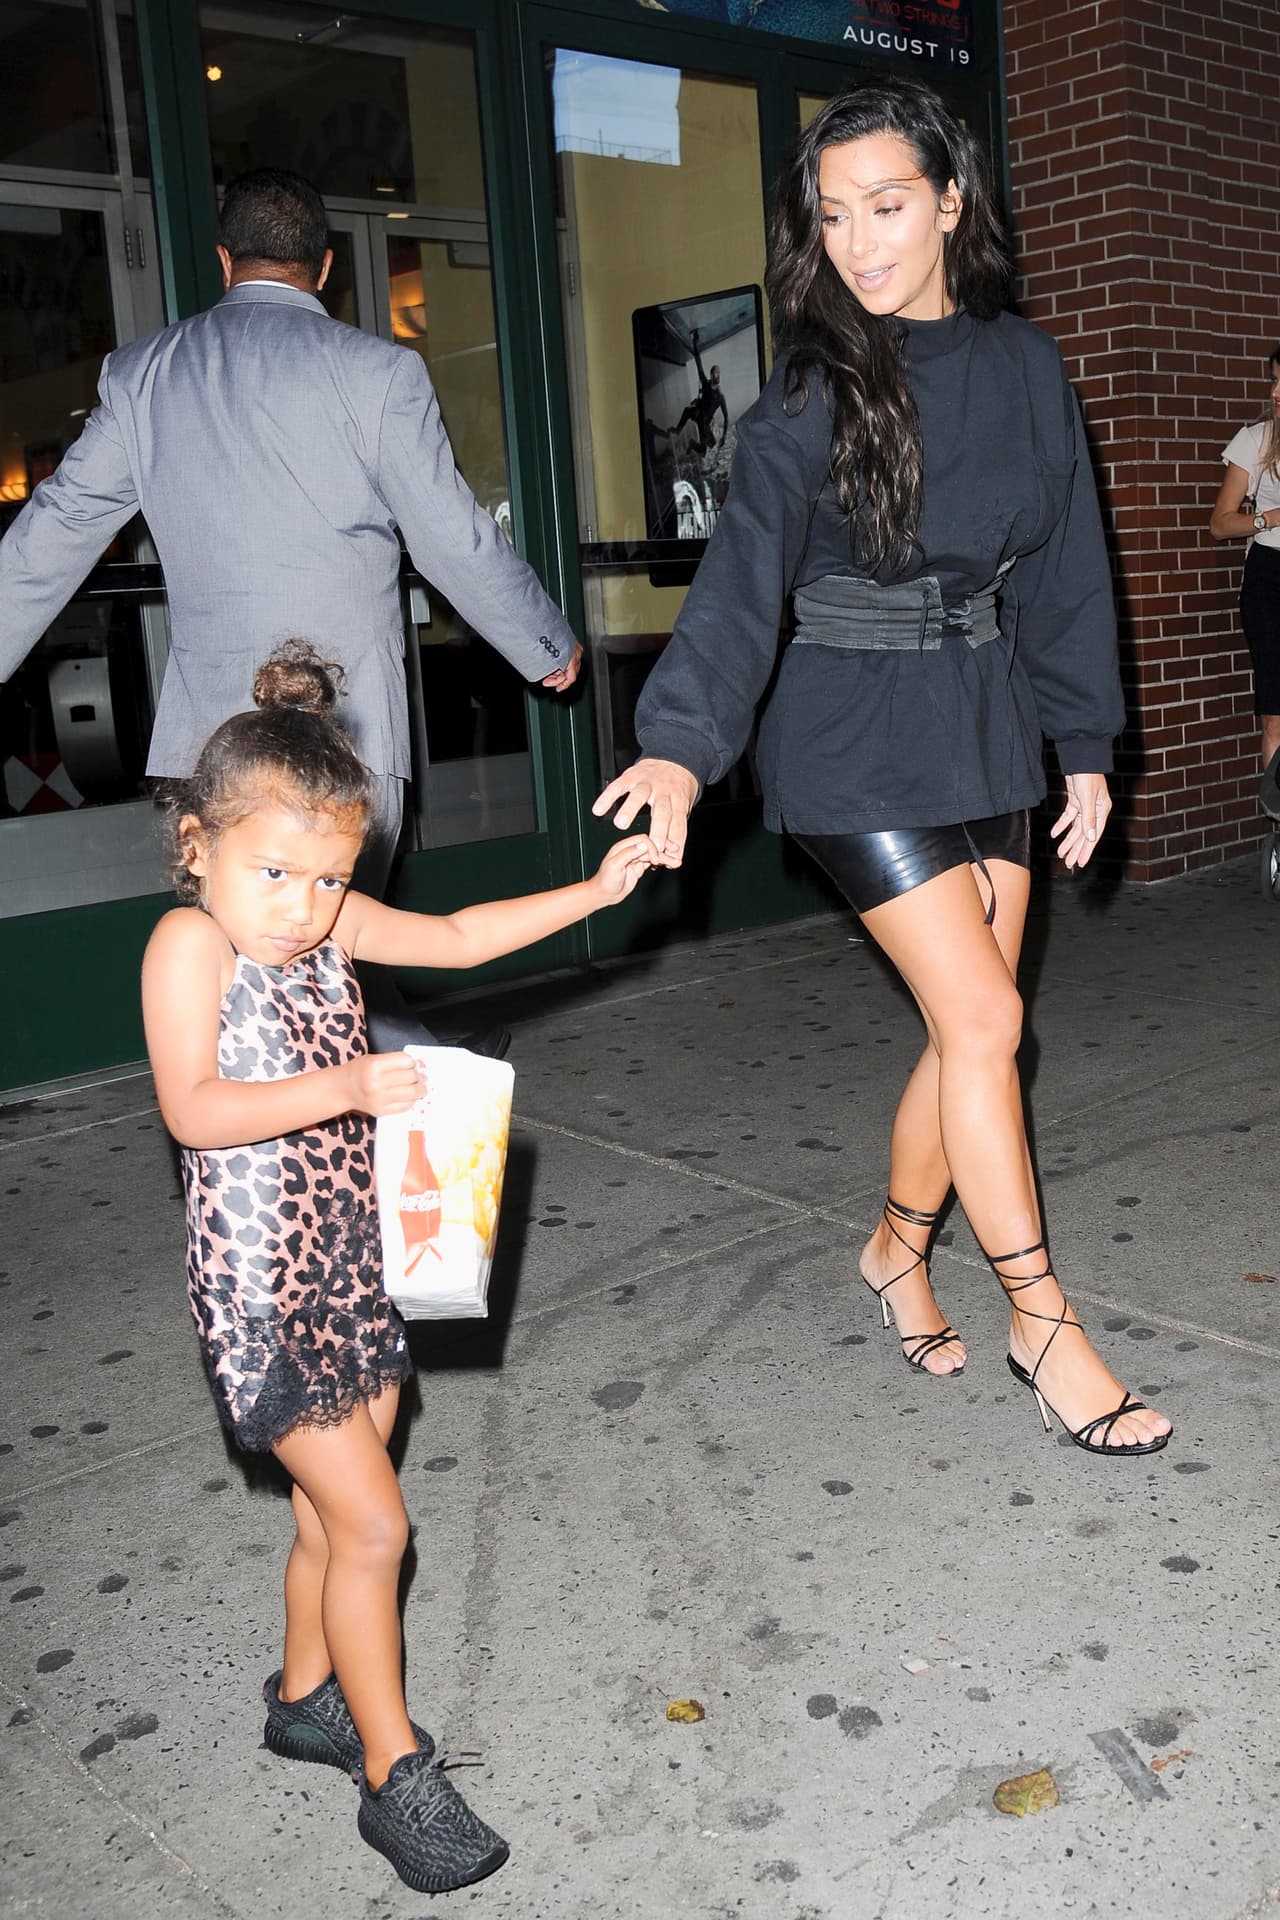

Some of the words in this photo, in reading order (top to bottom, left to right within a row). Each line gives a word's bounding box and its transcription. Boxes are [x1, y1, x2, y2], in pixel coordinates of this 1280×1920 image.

[904, 4, 961, 30] STRINGS
[842, 25, 939, 58] AUGUST
[949, 47, 970, 65] 19
